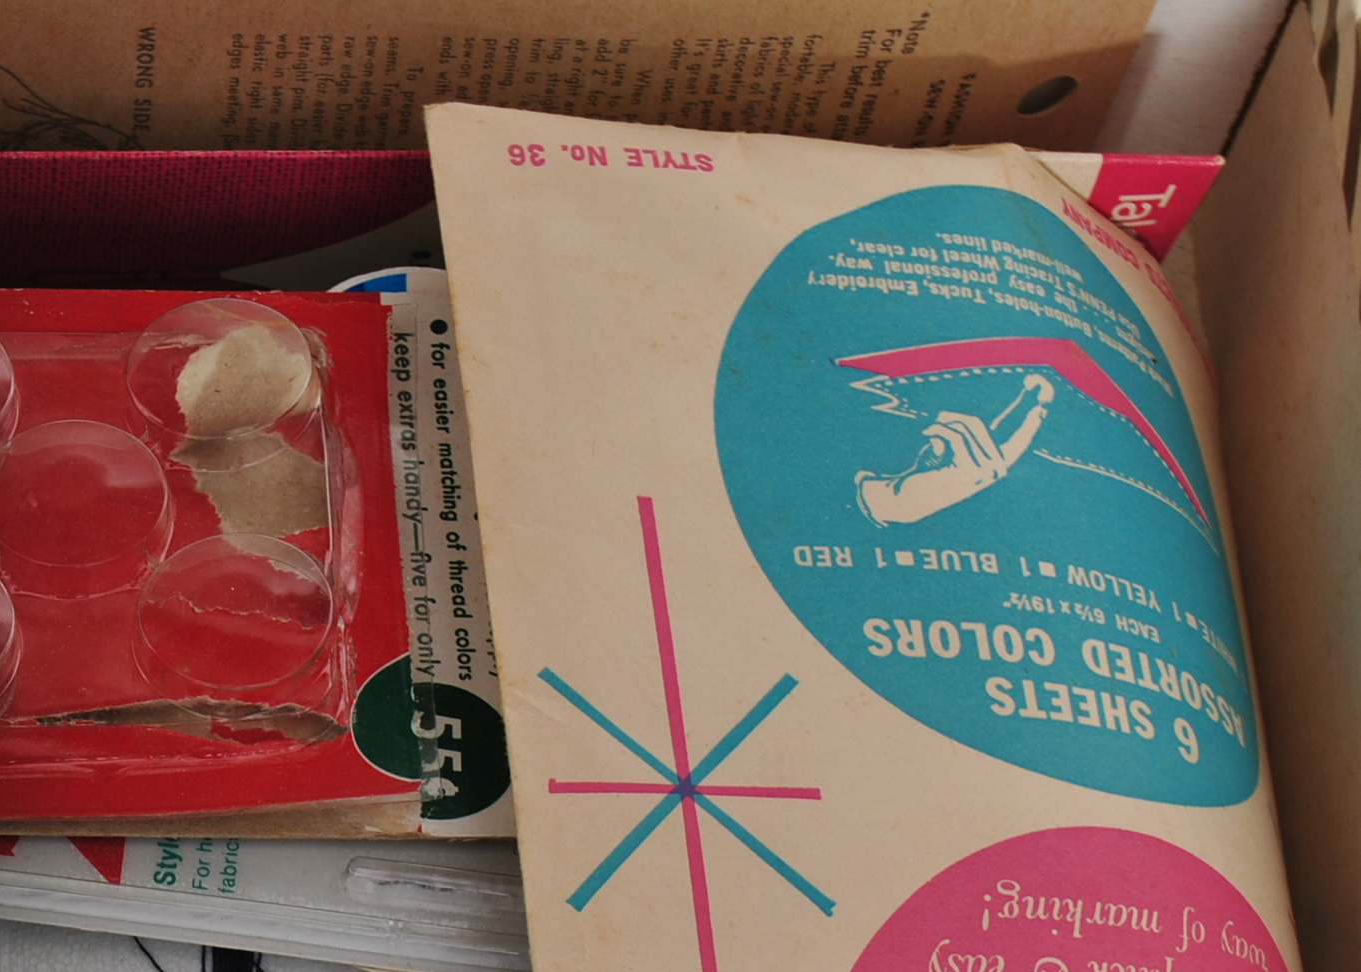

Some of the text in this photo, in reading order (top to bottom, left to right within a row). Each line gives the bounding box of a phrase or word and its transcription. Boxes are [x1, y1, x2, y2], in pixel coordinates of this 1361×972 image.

[227, 33, 249, 70] edges
[293, 36, 313, 82] straight
[439, 36, 457, 64] ends
[668, 38, 688, 71] other
[711, 38, 734, 69] skirts
[752, 36, 779, 78] fabrics
[775, 36, 794, 77] special
[881, 28, 903, 53] For
[132, 27, 155, 132] WRONG SIDE
[246, 34, 271, 109] elastic right
[564, 68, 585, 96] right
[683, 63, 702, 96] great
[725, 37, 756, 102] decorative
[840, 29, 876, 109] trim before
[506, 142, 714, 173] STYLE No. 36
[936, 231, 1084, 284] well-marked lines.
[1061, 197, 1141, 271] COMPANY
[807, 270, 920, 296] Embroidery
[829, 253, 1078, 314] the easy professional way.
[849, 238, 1117, 320] PENN'S Tracing Wheel for clear,
[923, 277, 987, 304] Tucks,
[988, 288, 1093, 338] Button-holes,
[390, 332, 441, 677] keep extras for only
[430, 342, 476, 681] for easier matching of thread colors
[793, 545, 1162, 614] YELLOW BLUE RED
[862, 617, 1056, 667] COLORS
[1114, 613, 1161, 644] EACH
[984, 676, 1200, 765] 6 SHEETS
[192, 859, 210, 891] For
[982, 879, 1269, 972] way of marking!
